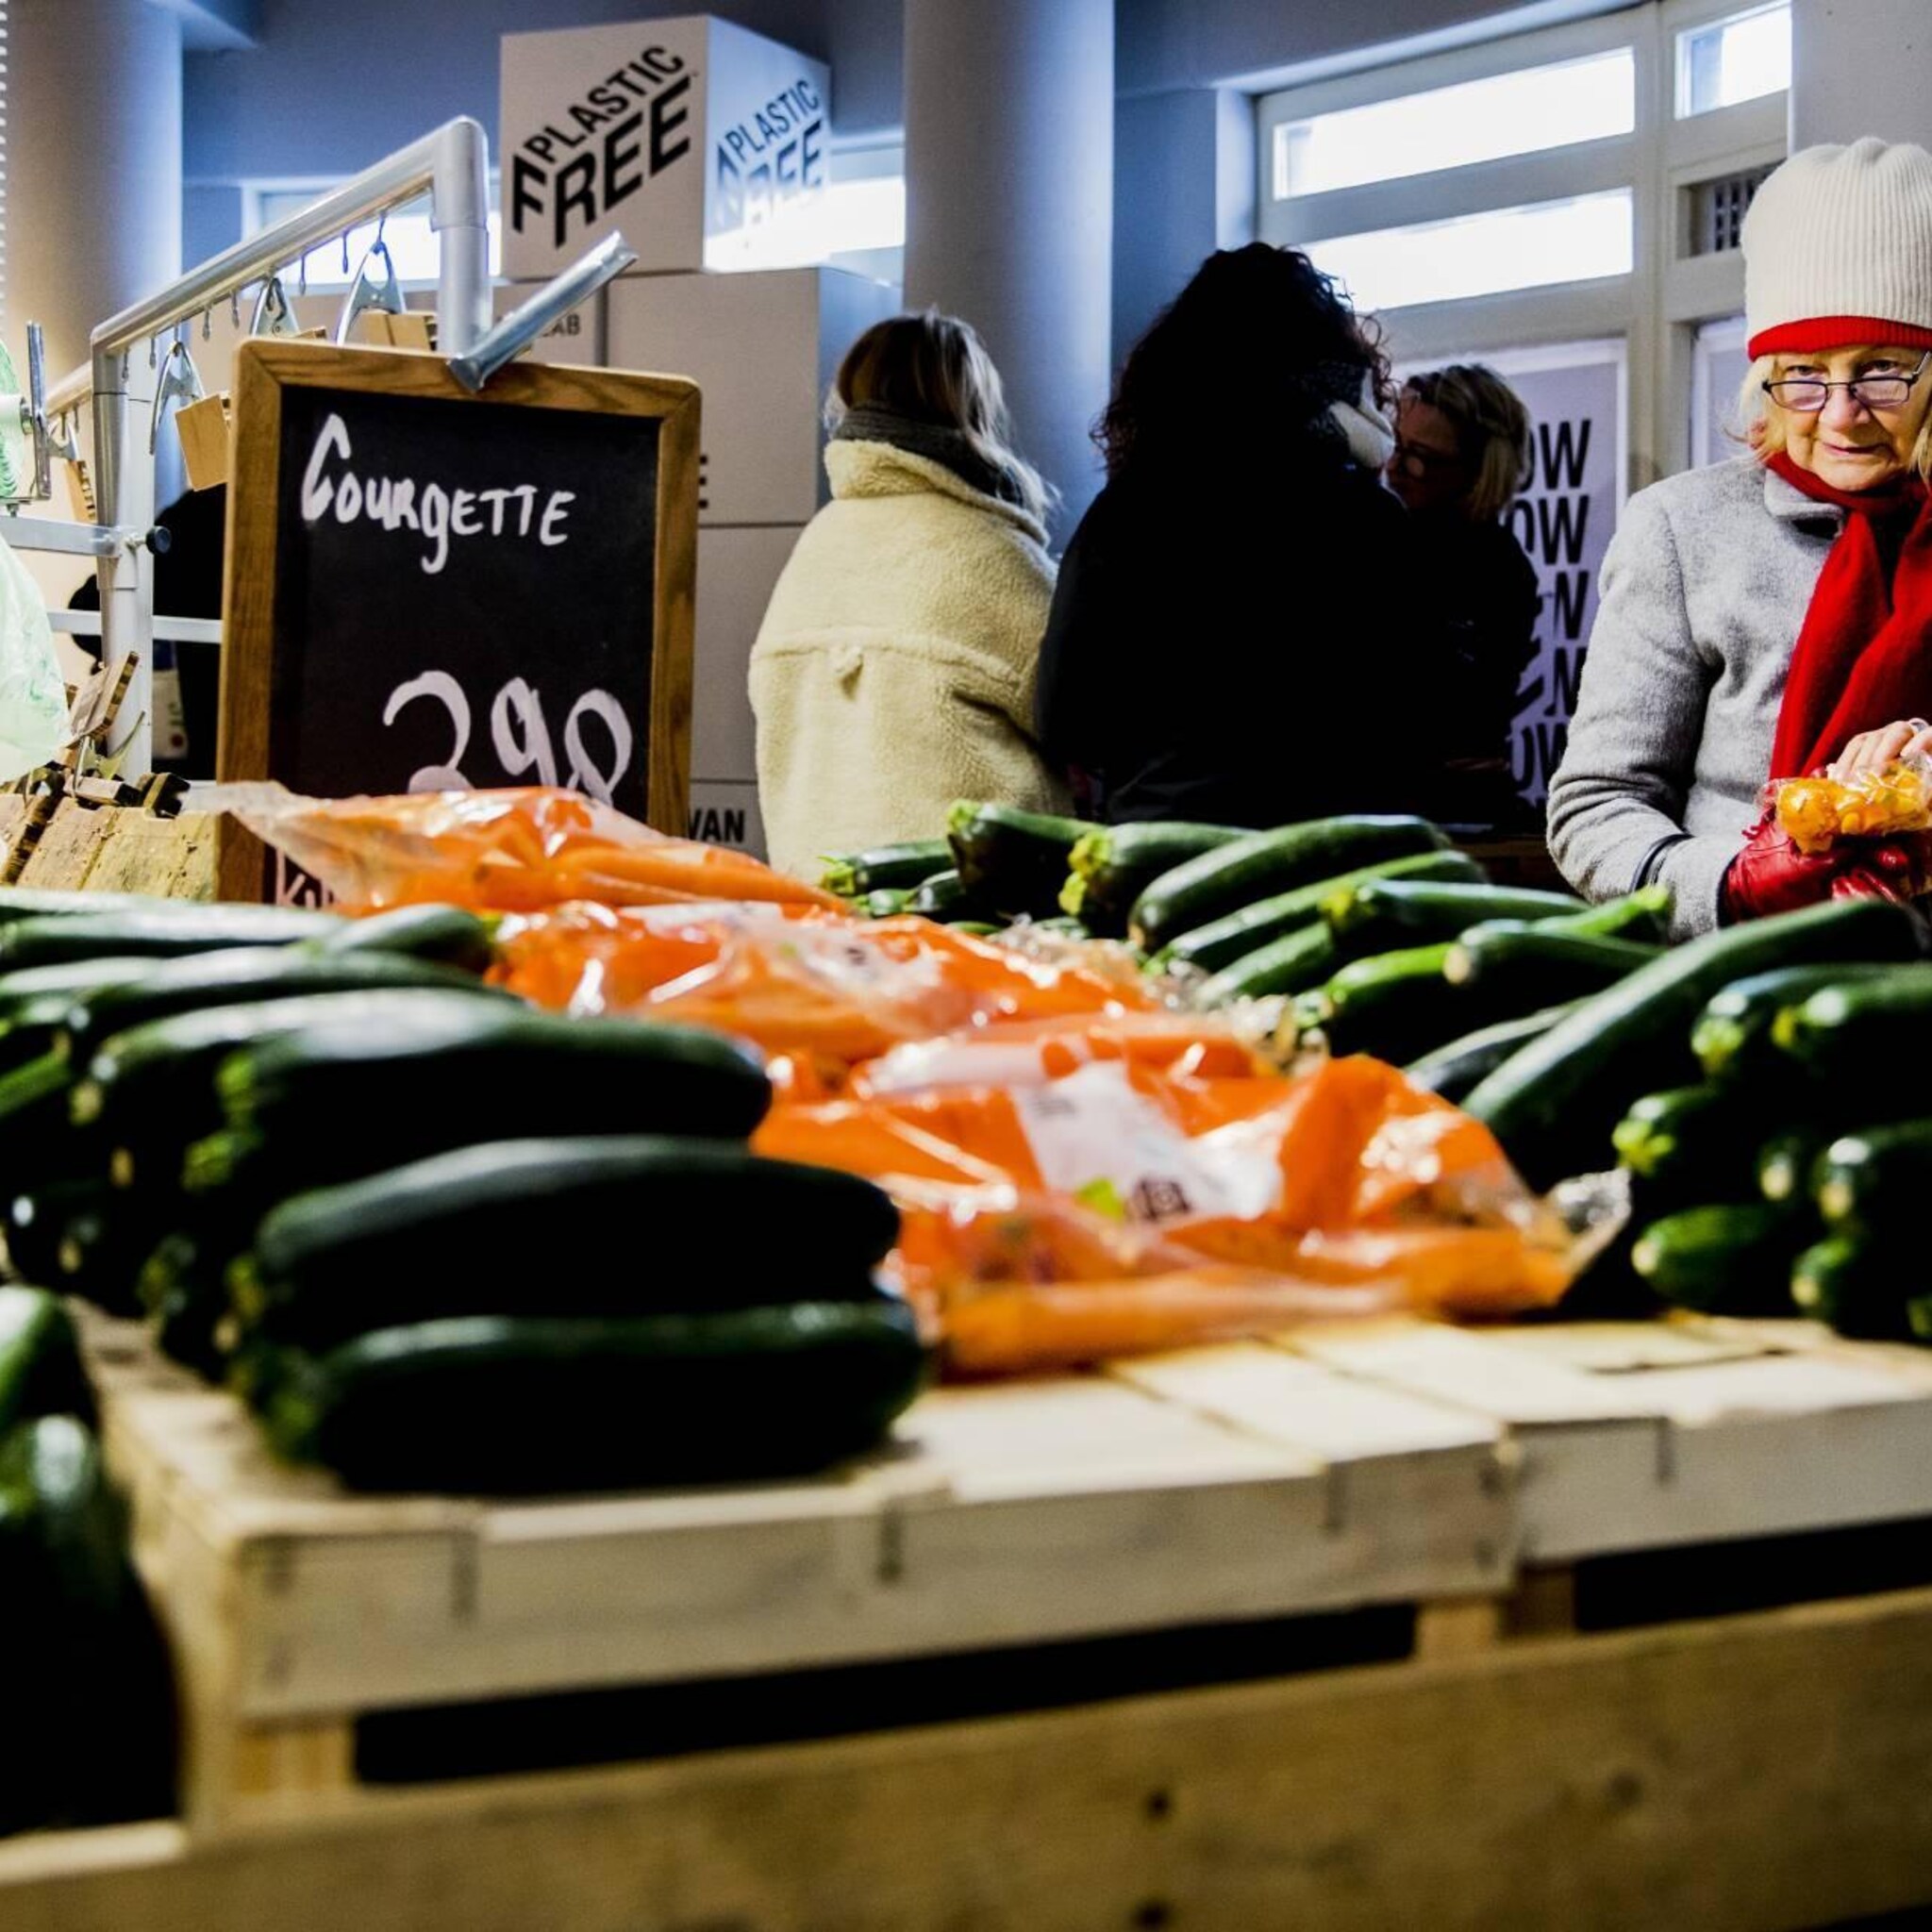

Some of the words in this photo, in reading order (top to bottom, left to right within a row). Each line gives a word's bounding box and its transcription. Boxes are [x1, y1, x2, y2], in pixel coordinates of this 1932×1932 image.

[524, 45, 686, 164] PLASTIC
[724, 78, 821, 164] PLASTIC
[512, 74, 692, 250] FREE
[542, 313, 581, 336] AB
[1507, 495, 1591, 565] OW
